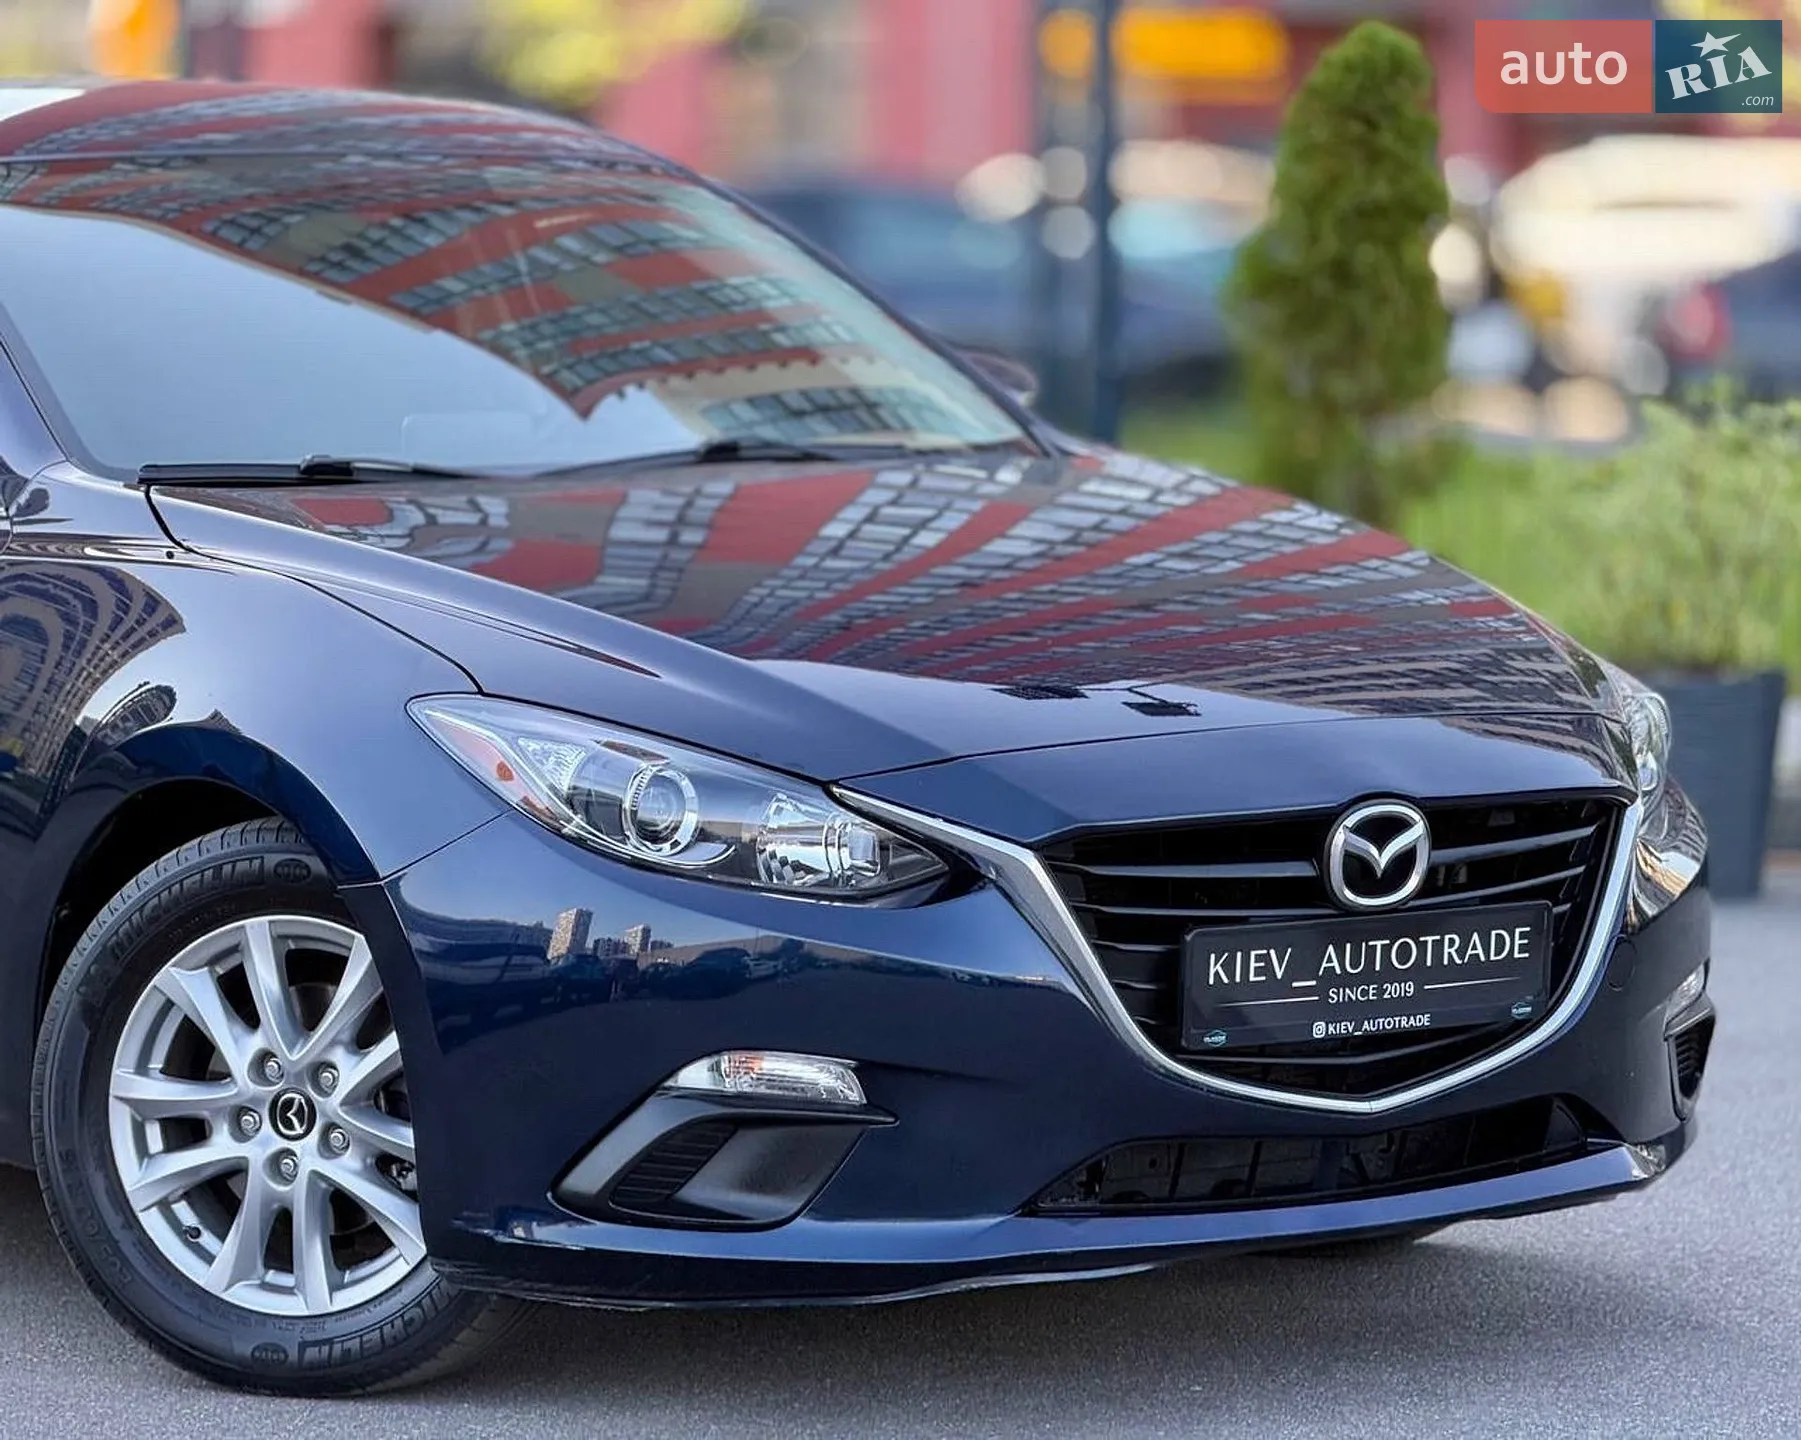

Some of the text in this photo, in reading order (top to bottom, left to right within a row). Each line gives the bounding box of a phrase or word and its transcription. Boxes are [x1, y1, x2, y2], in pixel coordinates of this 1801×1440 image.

[1208, 926, 1532, 988] KIEV_AUTOTRADE
[1328, 980, 1415, 1004] SINCE 2019
[1327, 1013, 1432, 1036] KIEV_AUTOTRADE
